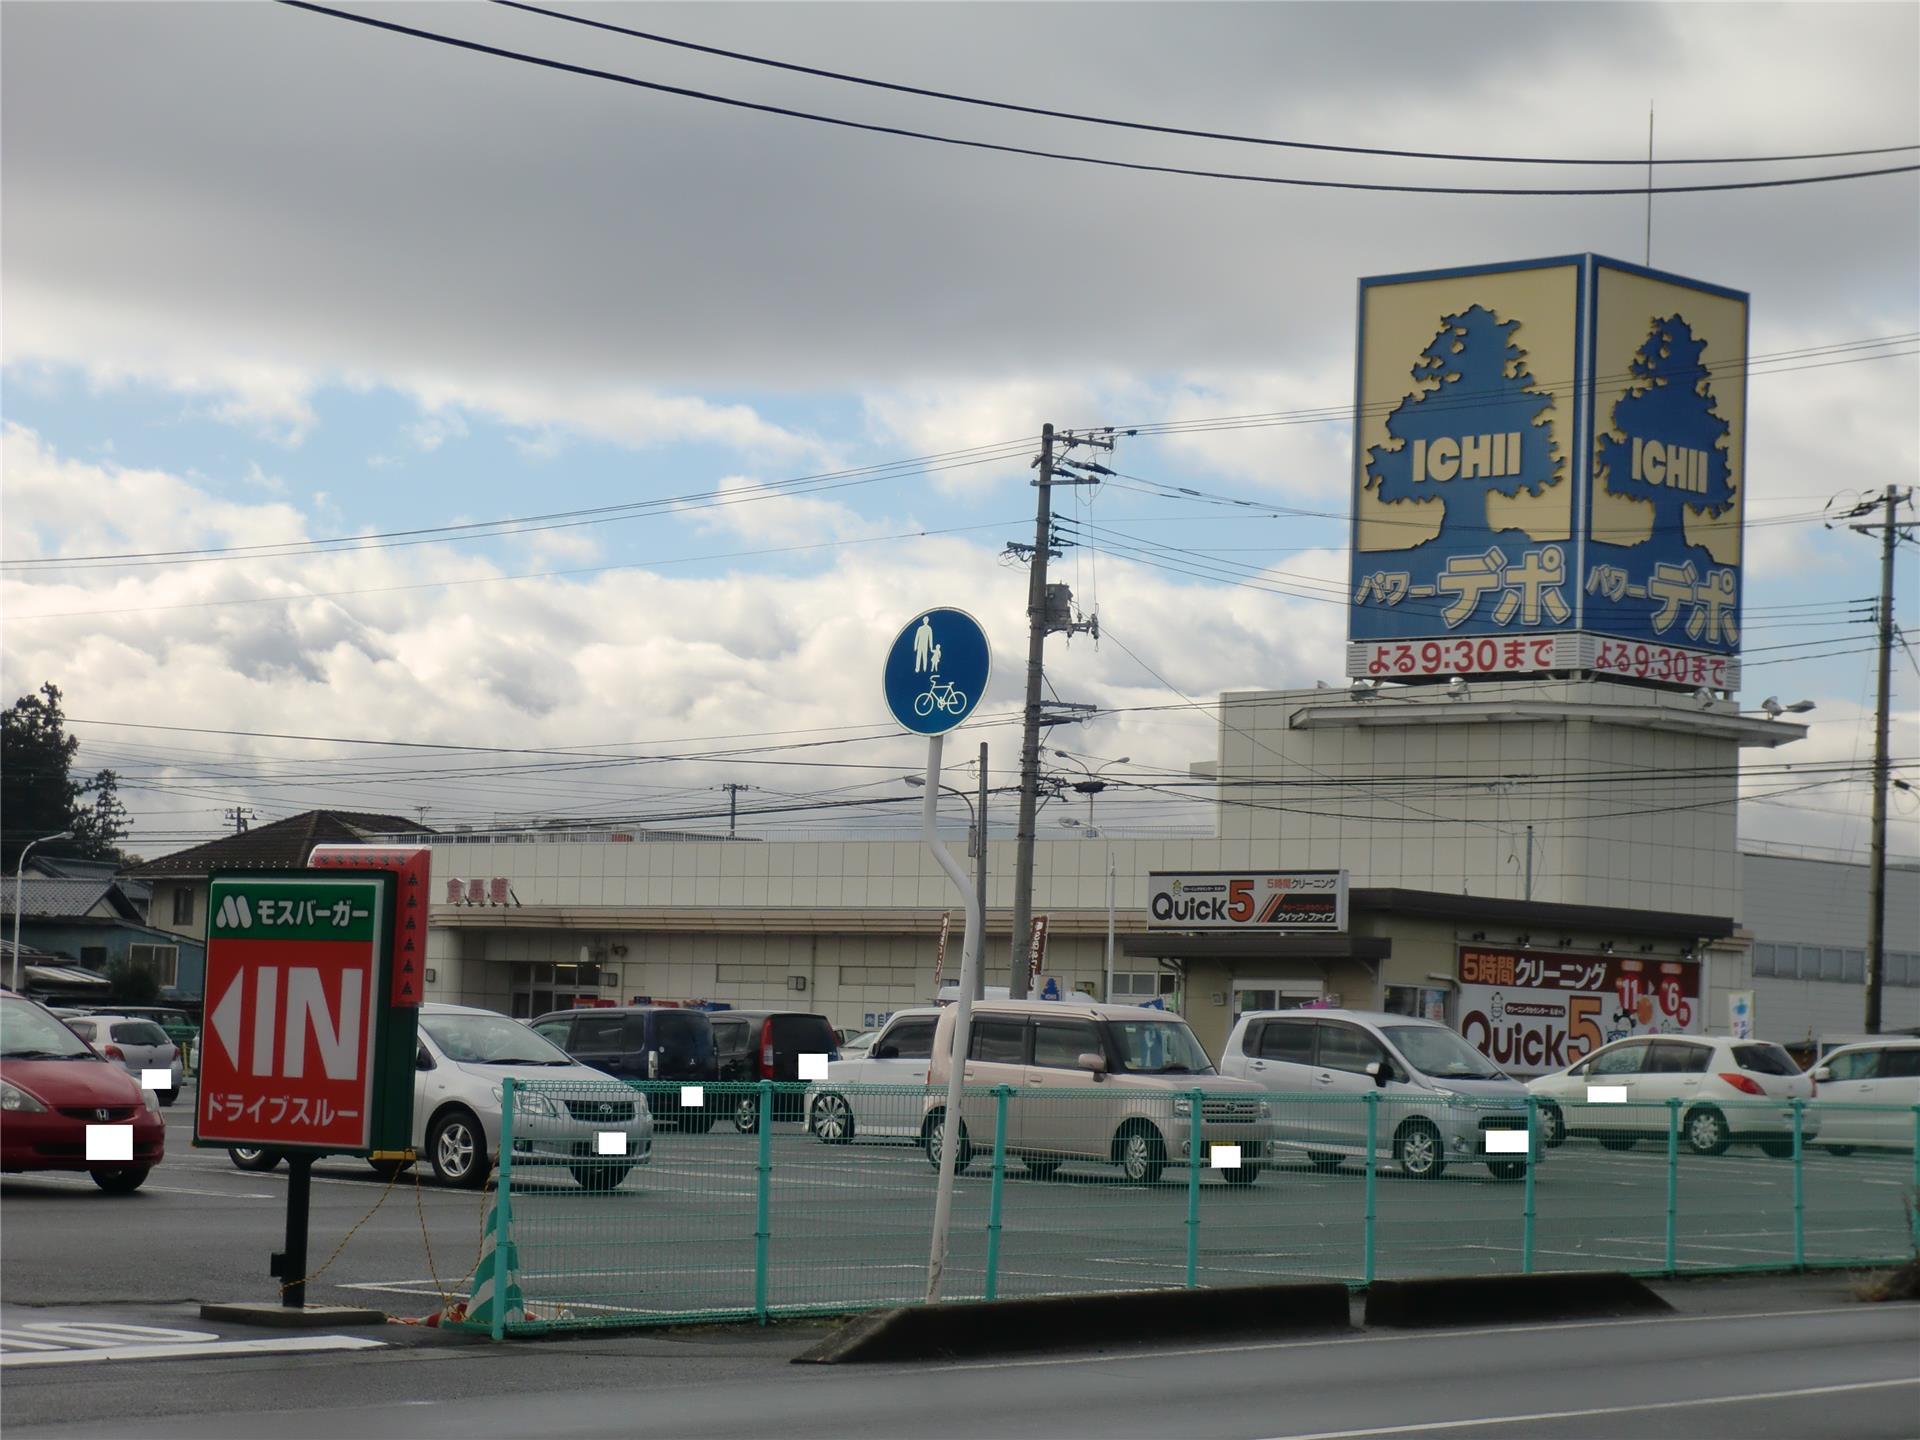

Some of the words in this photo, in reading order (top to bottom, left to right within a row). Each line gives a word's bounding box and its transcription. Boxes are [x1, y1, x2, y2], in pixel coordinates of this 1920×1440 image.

[1412, 432, 1522, 482] ICHII
[1631, 436, 1708, 494] ICHII
[1354, 544, 1572, 629] パワーデポ
[1585, 560, 1740, 647] パワーデポ
[1368, 638, 1554, 675] よる9:30まで
[1595, 640, 1728, 686] よる9:30まで
[257, 899, 369, 927] モスバーガー
[1463, 952, 1607, 990] 5時間クリーニング
[252, 966, 363, 1080] IN
[207, 1092, 359, 1127] ドライブスルー
